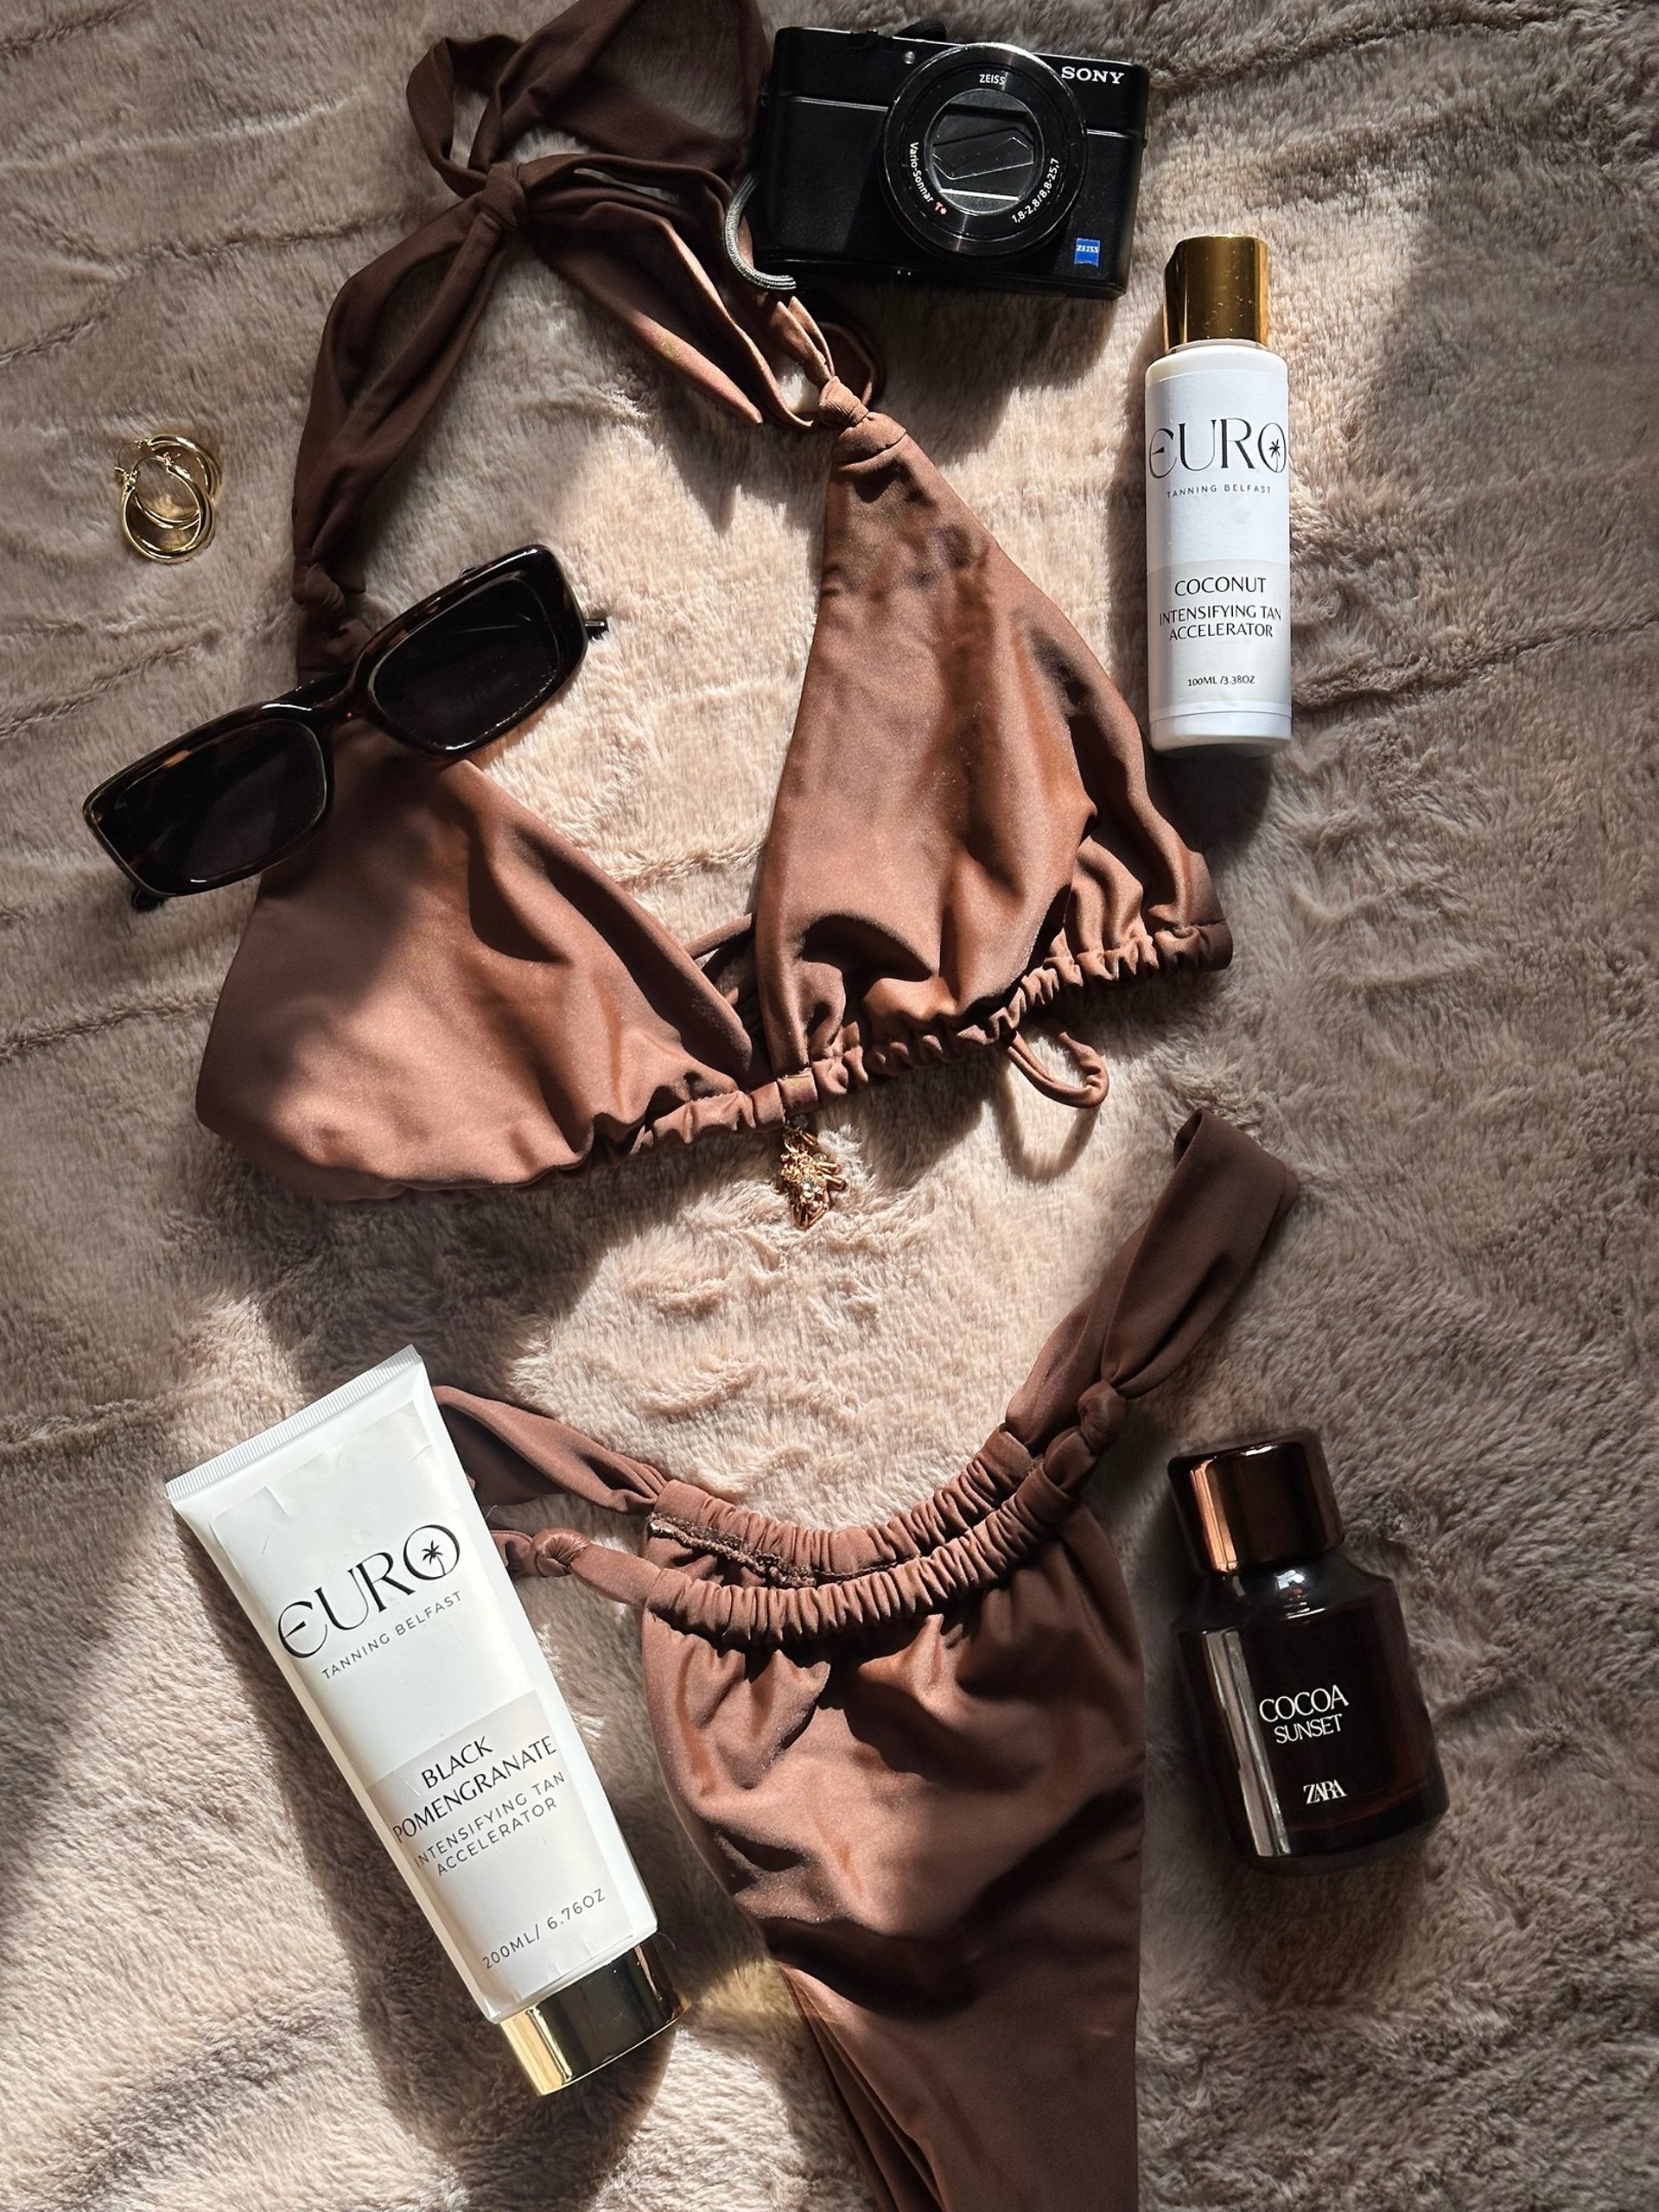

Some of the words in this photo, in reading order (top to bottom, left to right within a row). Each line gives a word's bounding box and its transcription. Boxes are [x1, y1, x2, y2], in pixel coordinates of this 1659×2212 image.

[979, 73, 1006, 85] ZEISS
[1061, 67, 1125, 84] SONY
[910, 142, 934, 202] Vario-Sonnar
[1076, 245, 1099, 253] ZEISS
[1149, 417, 1287, 479] EURO
[1166, 484, 1217, 499] TANNING
[1224, 482, 1272, 495] BELFAST
[1174, 576, 1267, 596] COCONUT
[1160, 604, 1256, 626] INTENSIFYING
[1260, 606, 1282, 620] TAN
[1169, 622, 1273, 641] ACCELERATOR
[1187, 677, 1217, 687] 100ML
[277, 1524, 461, 1659] EURO
[321, 1633, 391, 1681] TANNING
[395, 1590, 463, 1638] BELFAST
[1259, 1684, 1349, 1723] COCOA
[1274, 1713, 1344, 1745] SUNSET
[421, 1736, 493, 1789] BLACK
[392, 1735, 557, 1844] POMENGRANATE
[1303, 1778, 1348, 1805] ZARA
[415, 1793, 528, 1868] INTENSIFYING
[531, 1770, 565, 1796] TAN
[437, 1797, 557, 1876] ACCELERATOR
[482, 1923, 541, 1969] 200ML/
[546, 1888, 606, 1929] 6.76OZ
